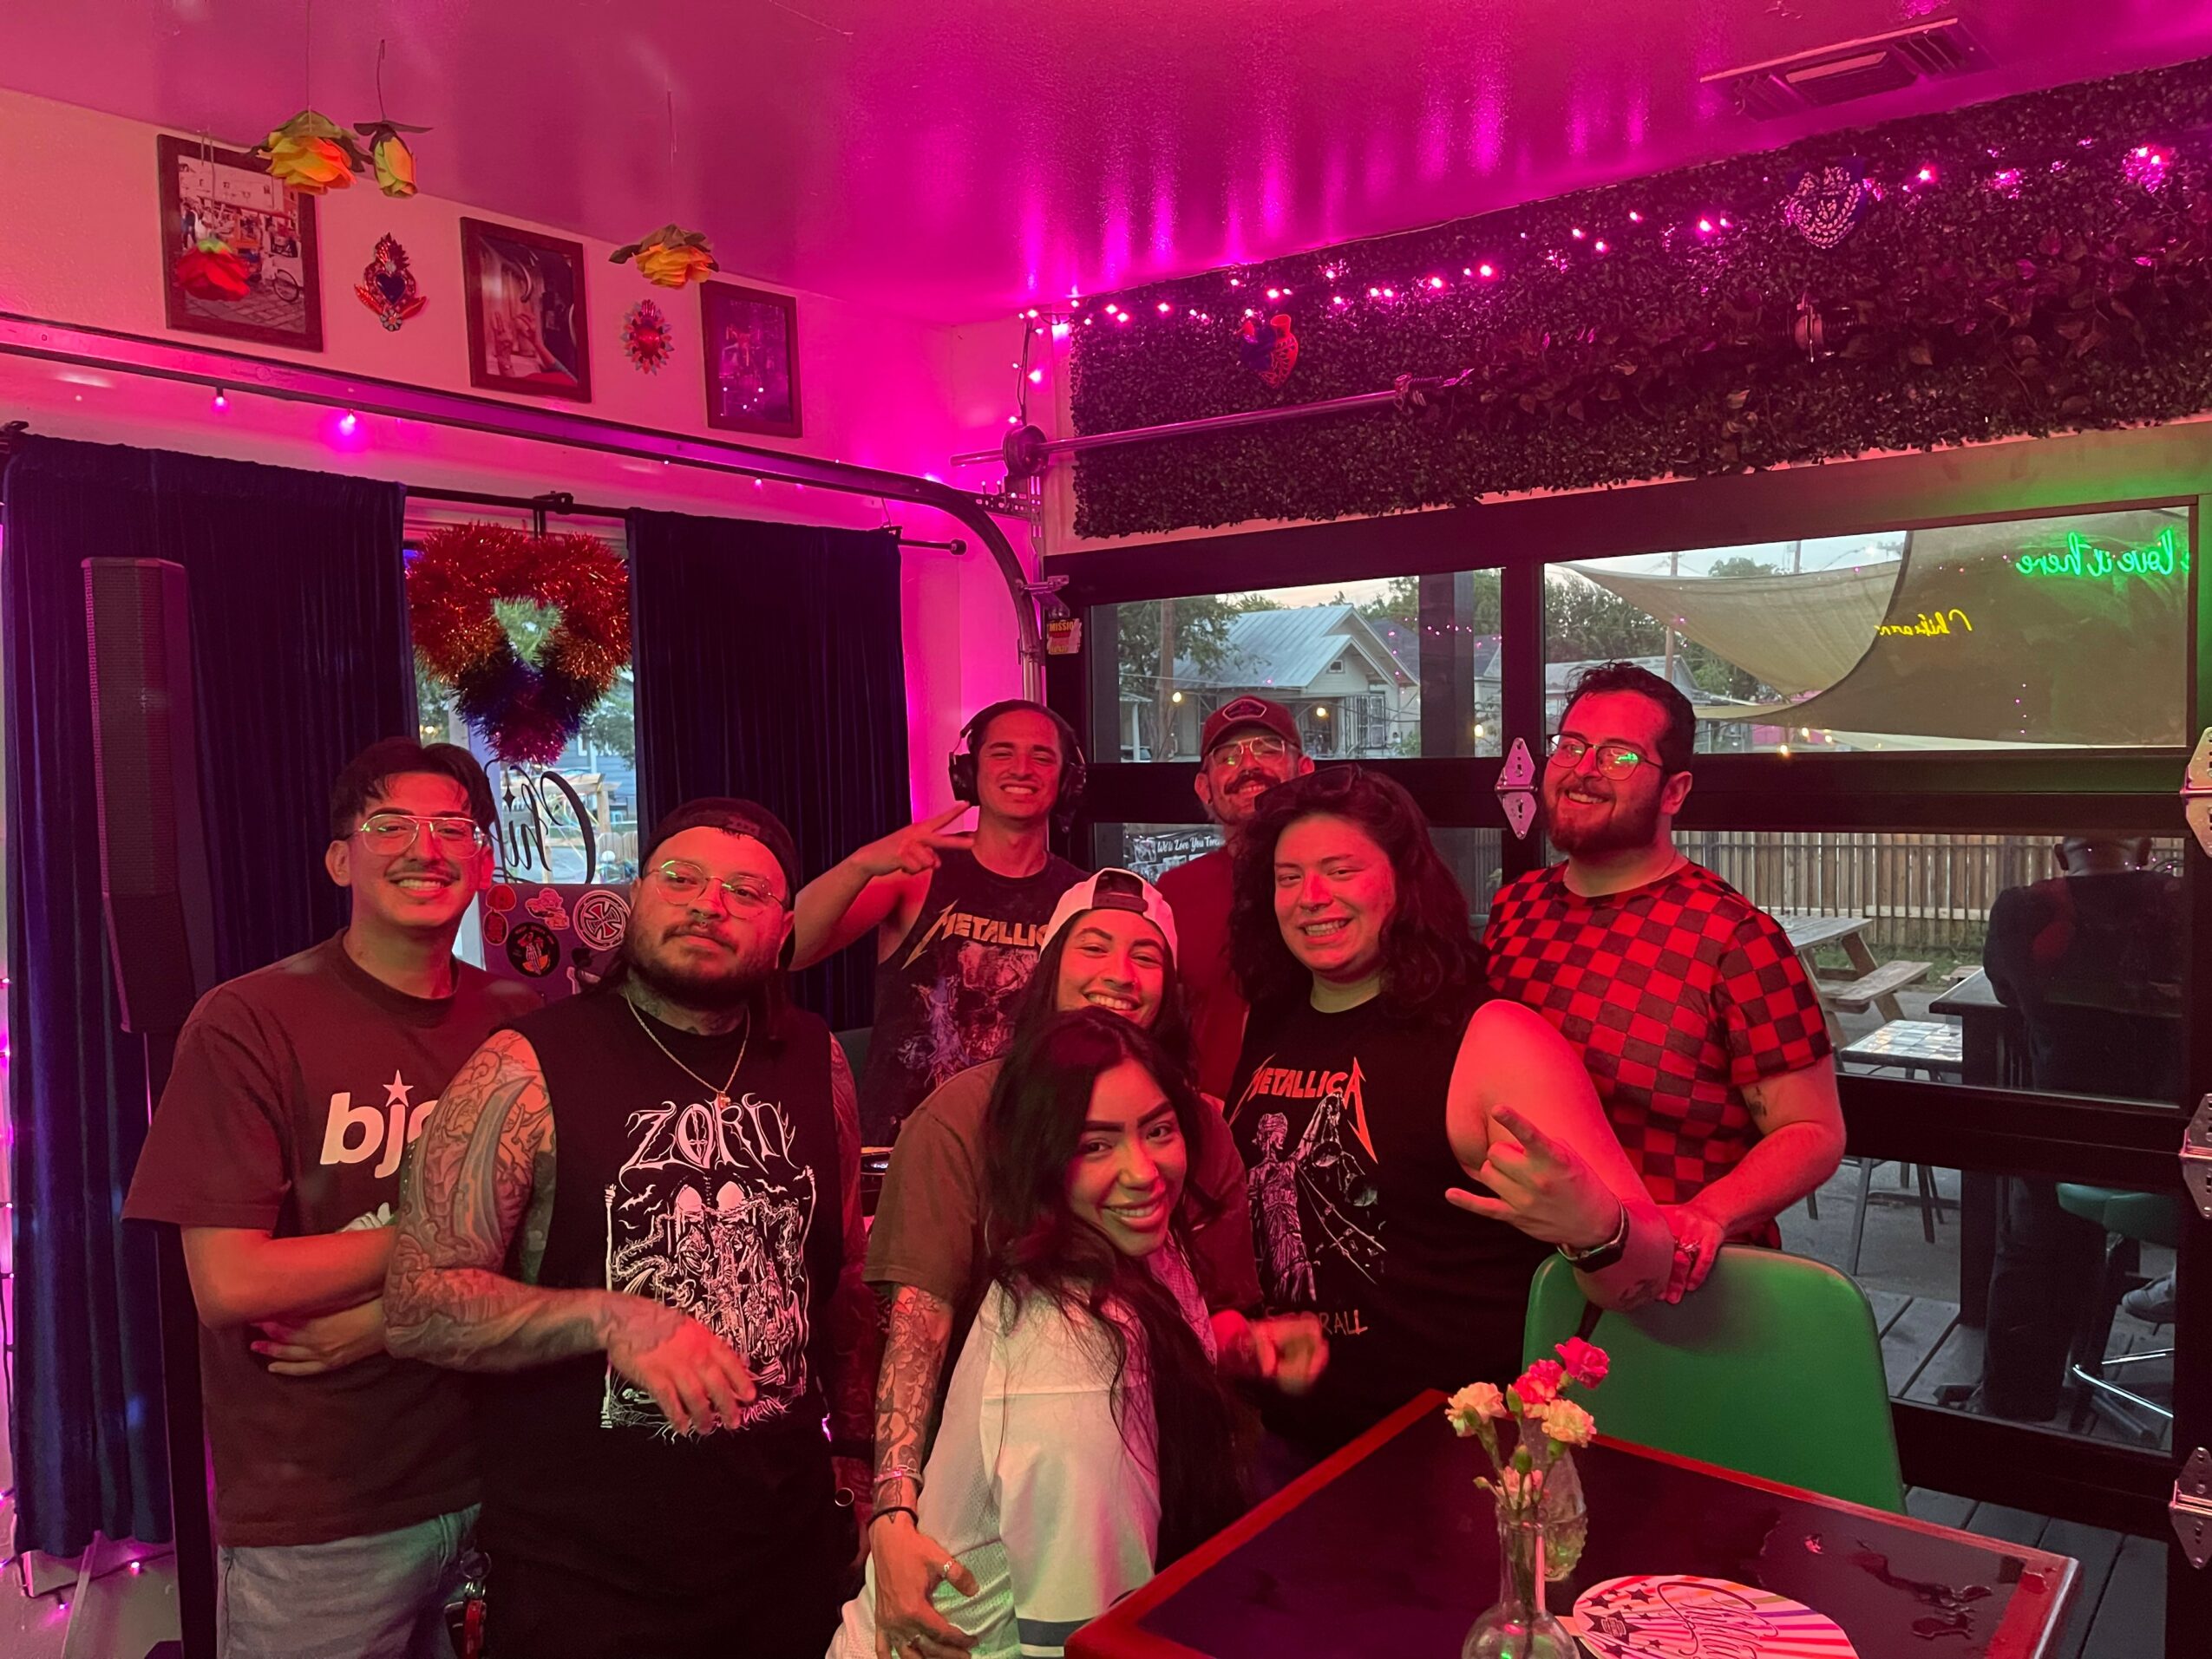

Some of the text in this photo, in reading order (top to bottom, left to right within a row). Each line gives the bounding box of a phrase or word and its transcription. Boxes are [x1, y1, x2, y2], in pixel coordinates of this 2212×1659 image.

[1049, 621, 1075, 632] MISSIO
[1190, 836, 1204, 852] You
[900, 898, 1050, 971] METALLIC
[618, 1093, 802, 1194] ZORN
[1228, 1053, 1379, 1165] METALLICA
